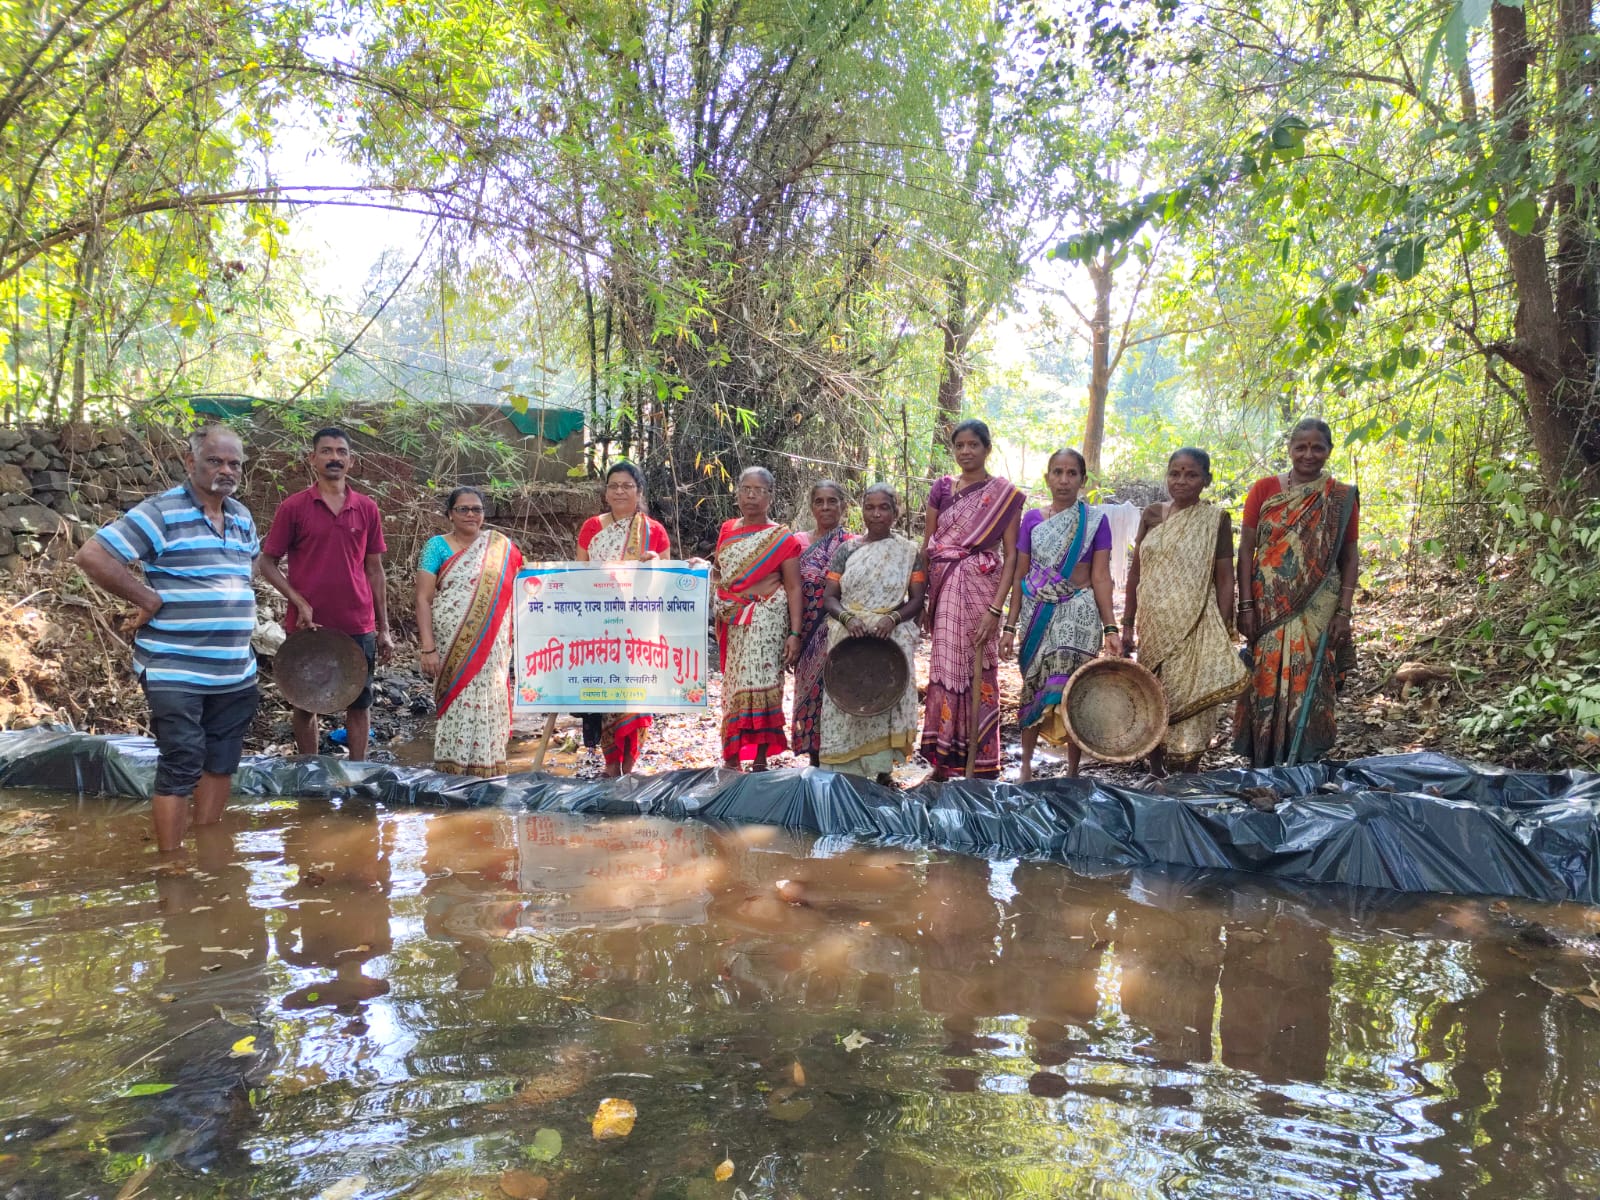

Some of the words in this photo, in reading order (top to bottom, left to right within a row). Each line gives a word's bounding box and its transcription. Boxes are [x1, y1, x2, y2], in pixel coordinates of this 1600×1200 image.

[528, 597, 544, 614] उमेद
[554, 600, 582, 617] महाराष्ट्र
[584, 600, 602, 613] राज्य
[604, 597, 626, 613] ग्रामीण
[666, 596, 695, 613] अभियान
[525, 636, 565, 678] प्रगति
[568, 629, 621, 671] ग्रामसंघ
[625, 628, 670, 670] वेरवली
[624, 674, 657, 684] रत्नागिरी
